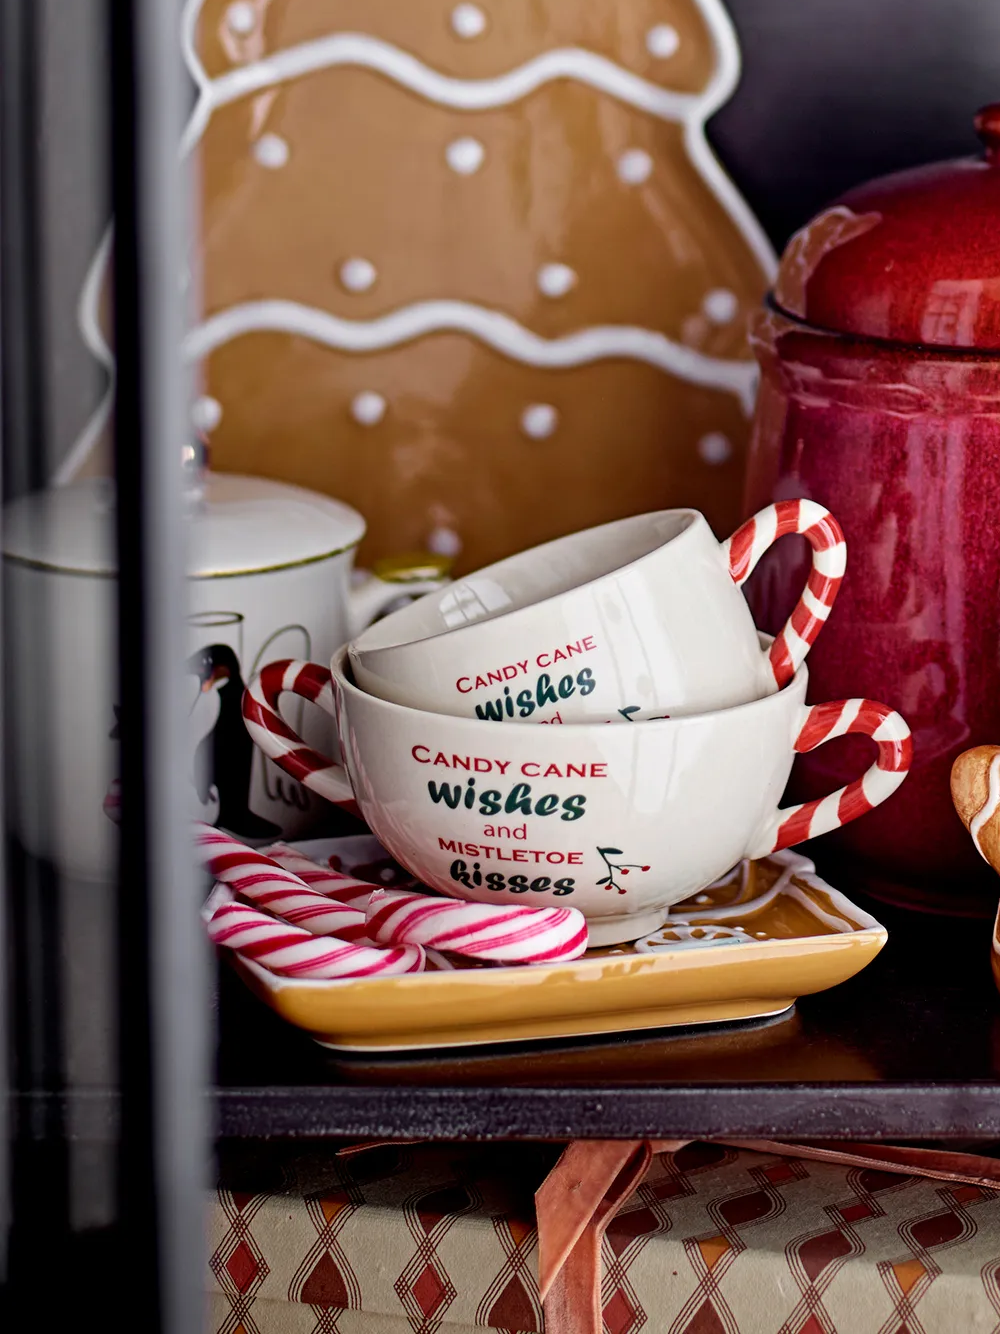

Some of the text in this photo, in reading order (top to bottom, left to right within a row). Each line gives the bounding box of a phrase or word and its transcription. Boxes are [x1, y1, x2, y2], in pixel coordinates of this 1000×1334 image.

[455, 635, 597, 694] CANDY CANE
[474, 667, 597, 722] wishes
[411, 744, 609, 778] CANDY CANE
[427, 777, 587, 822] wishes
[437, 837, 584, 865] MISTLETOE
[483, 823, 528, 841] and
[450, 858, 576, 896] kisses
